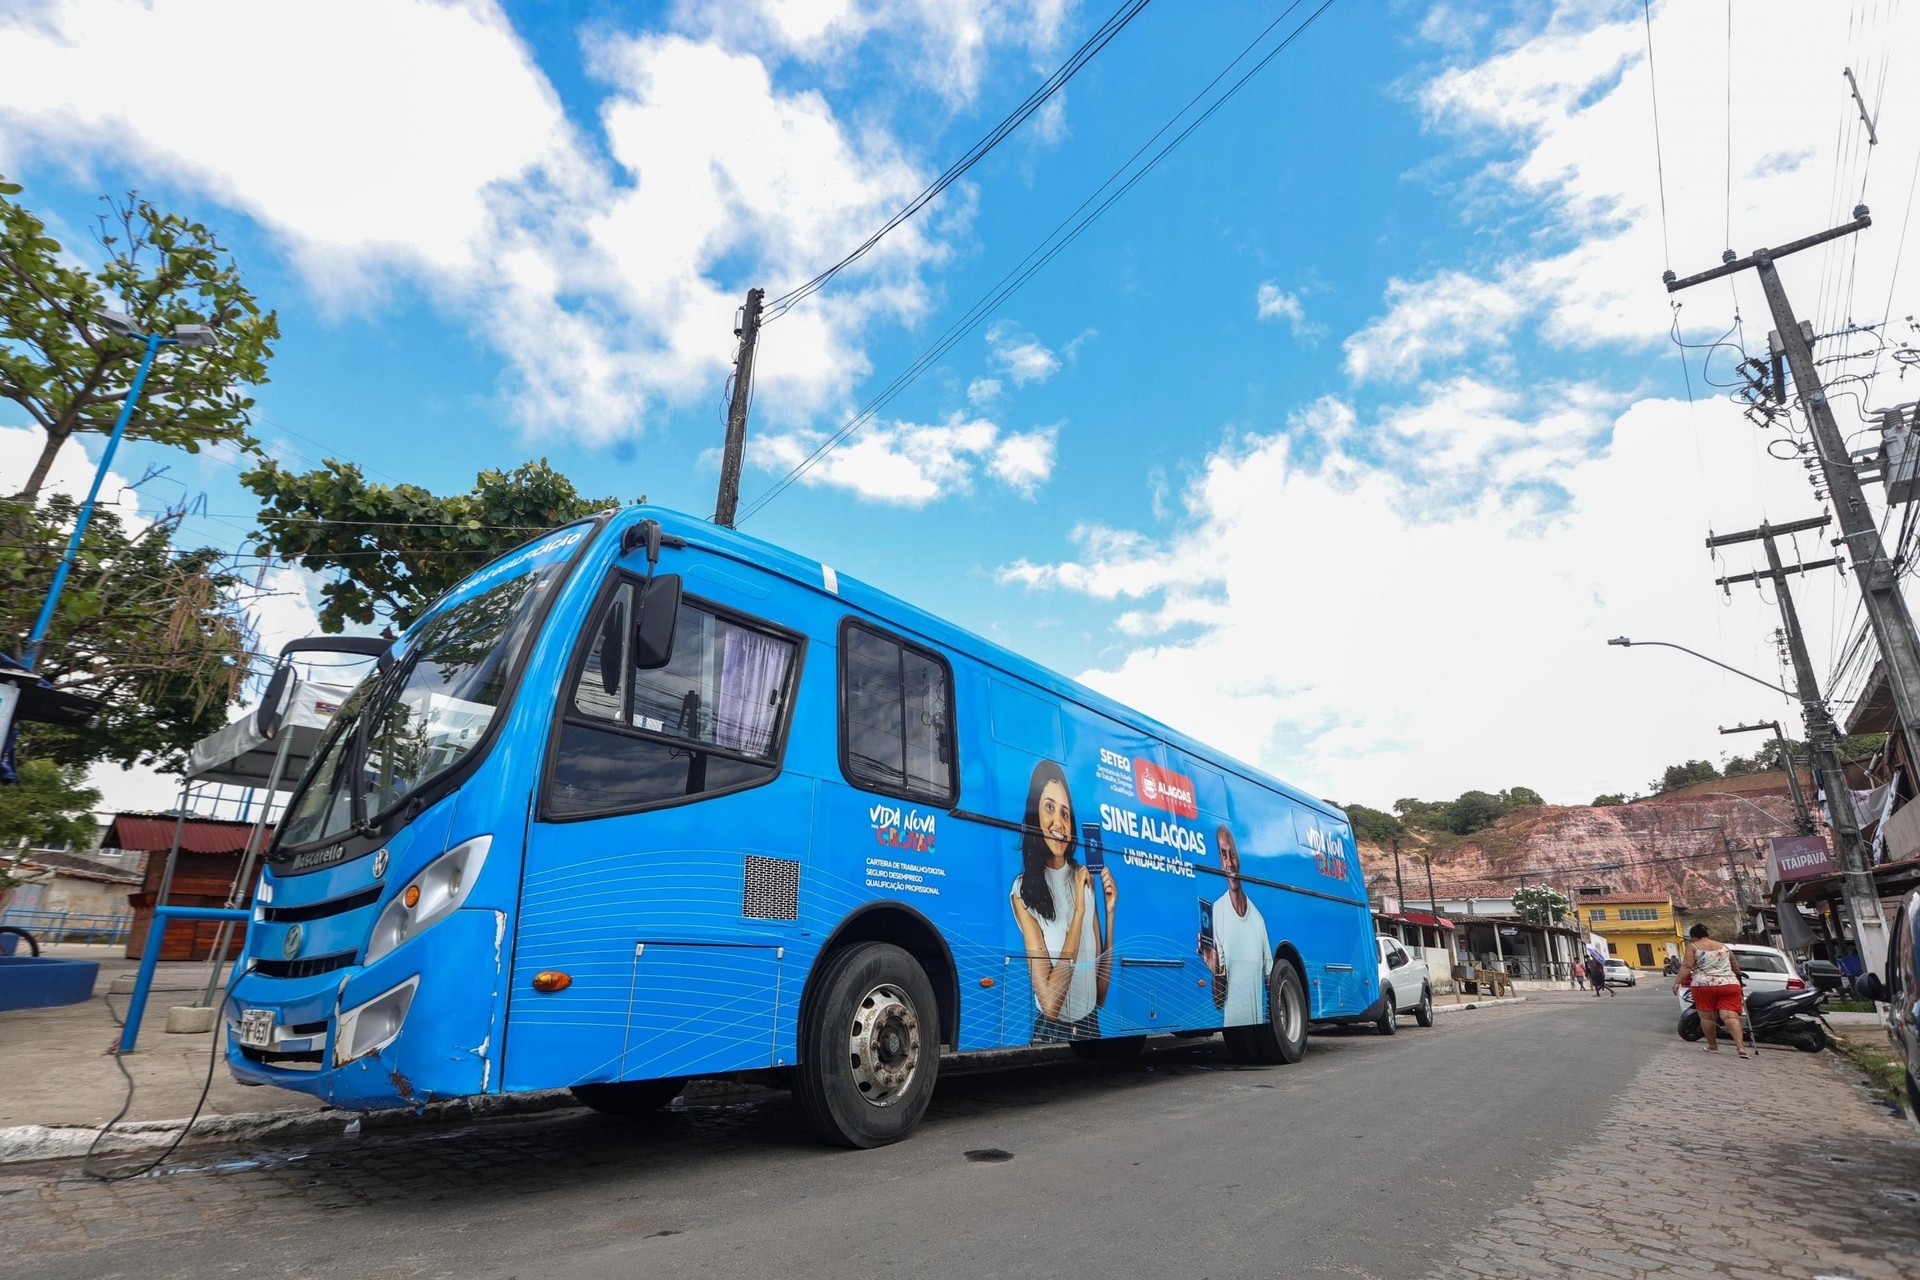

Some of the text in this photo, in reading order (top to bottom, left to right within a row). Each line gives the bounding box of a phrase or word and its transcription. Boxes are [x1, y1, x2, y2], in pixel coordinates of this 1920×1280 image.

[1100, 748, 1131, 772] SETEQ
[1158, 781, 1192, 804] ALAGOAS
[869, 803, 936, 834] VIDA NOVA
[1100, 803, 1207, 856] SINE ALAGOAS
[876, 827, 936, 854] GROTAS
[1306, 826, 1327, 854] VIDA
[293, 845, 344, 870] Mascarello
[866, 857, 947, 877] CARTEIRA DE TRABALHO/DIGITAL
[1123, 847, 1196, 878] UNIDADE MÓVEL
[1781, 850, 1828, 871] ITAIPAVA
[865, 879, 940, 896] QUALIFICAÇÃO PROFISSIONAL
[866, 868, 924, 883] SEGURO DESEMPREGO
